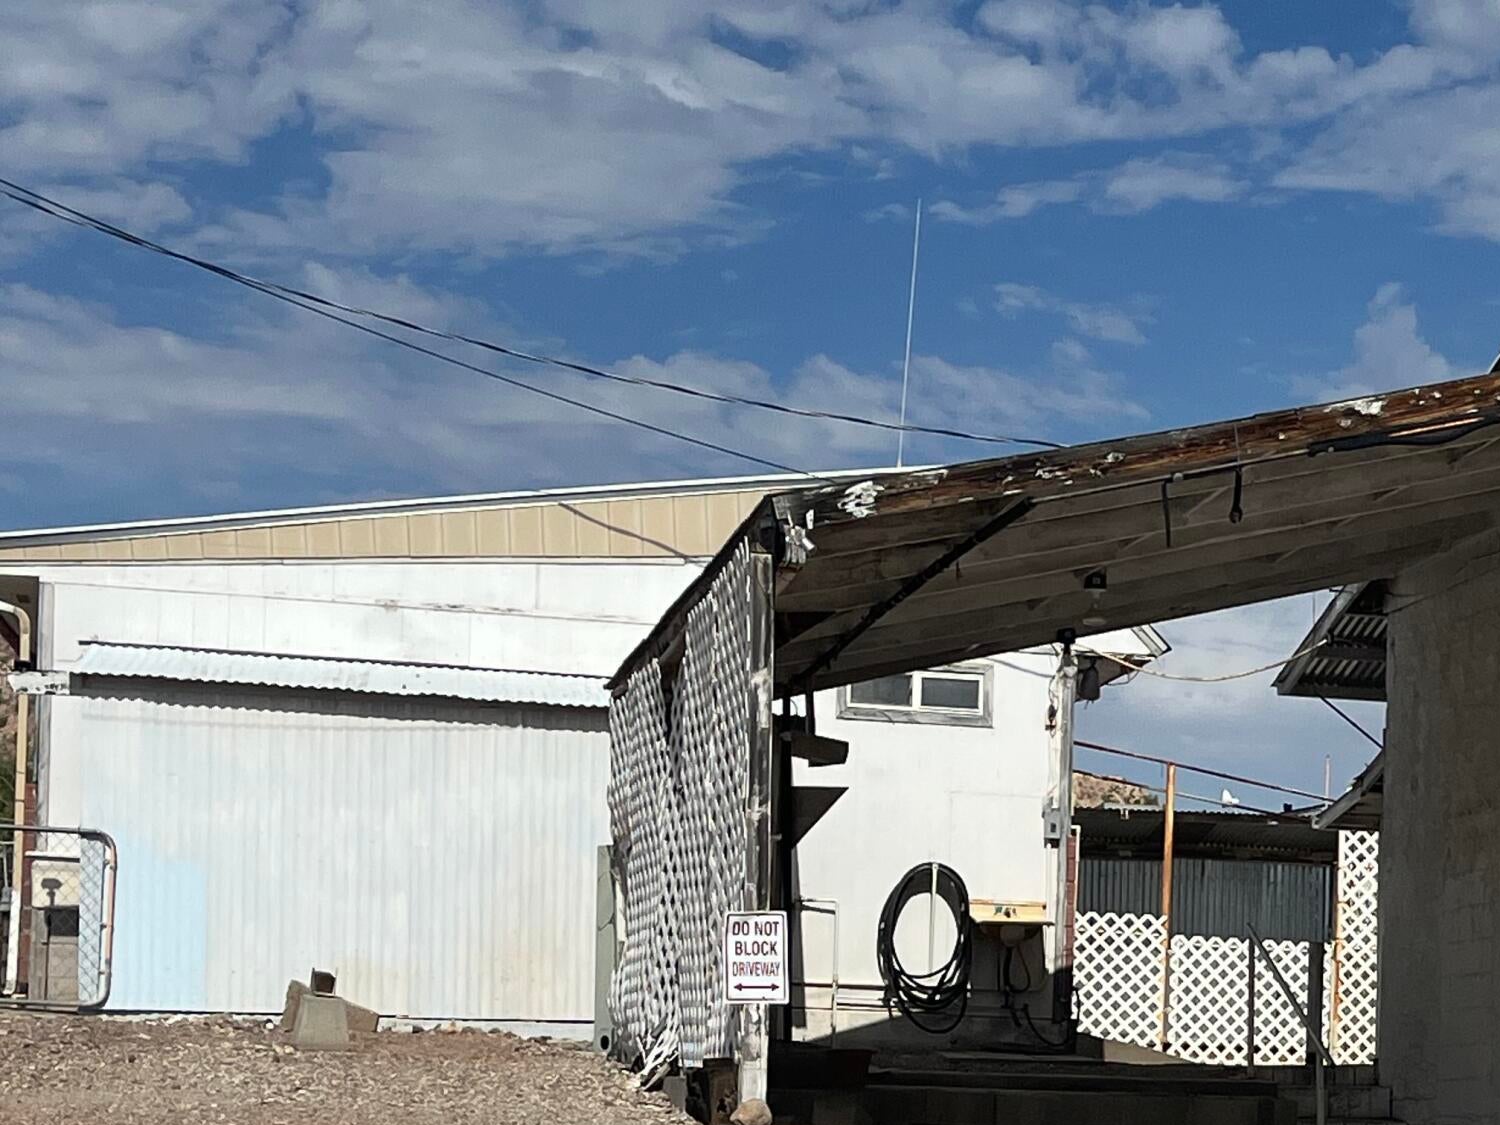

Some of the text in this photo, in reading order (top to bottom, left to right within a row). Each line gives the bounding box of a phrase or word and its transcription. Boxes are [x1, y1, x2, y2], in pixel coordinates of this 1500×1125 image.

[732, 921, 780, 936] DO NOT
[734, 941, 778, 956] BLOCK
[732, 961, 781, 977] DRIVEWAY
